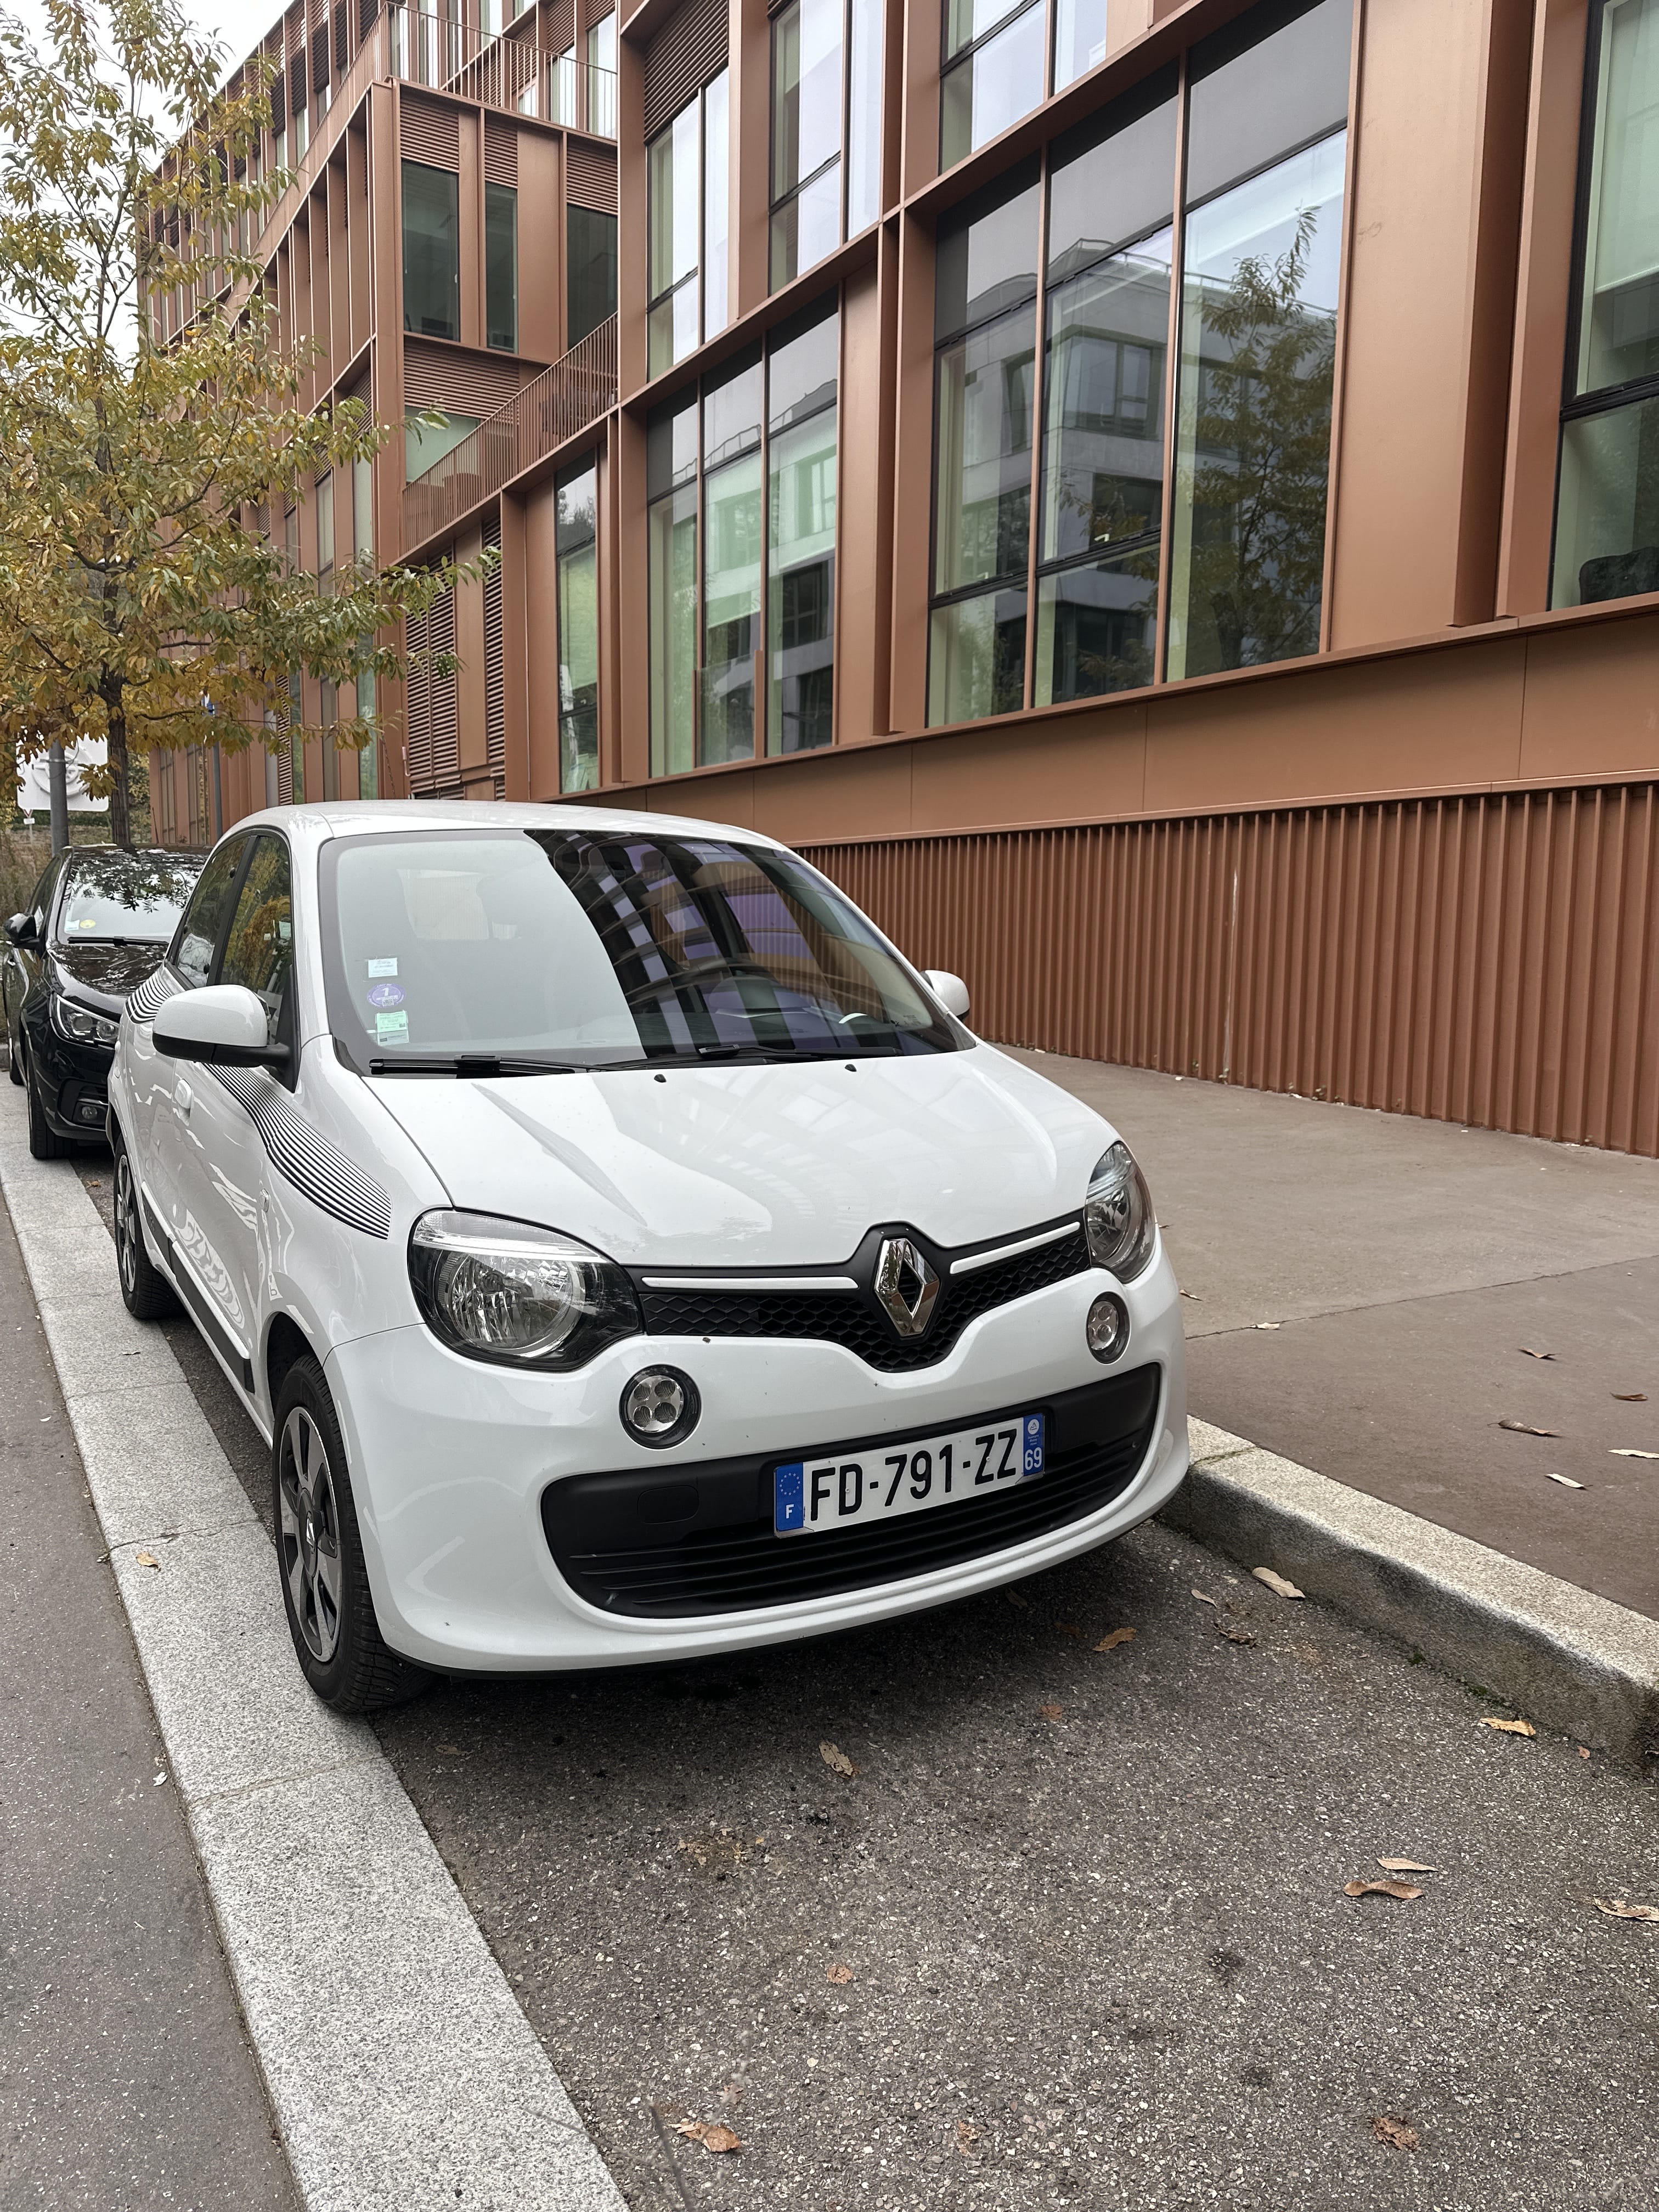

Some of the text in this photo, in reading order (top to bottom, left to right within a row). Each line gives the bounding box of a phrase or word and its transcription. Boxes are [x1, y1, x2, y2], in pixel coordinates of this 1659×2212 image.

[381, 987, 389, 996] 1
[1024, 1447, 1042, 1470] 69
[810, 1428, 1017, 1521] FD-791-ZZ
[786, 1504, 794, 1519] F
